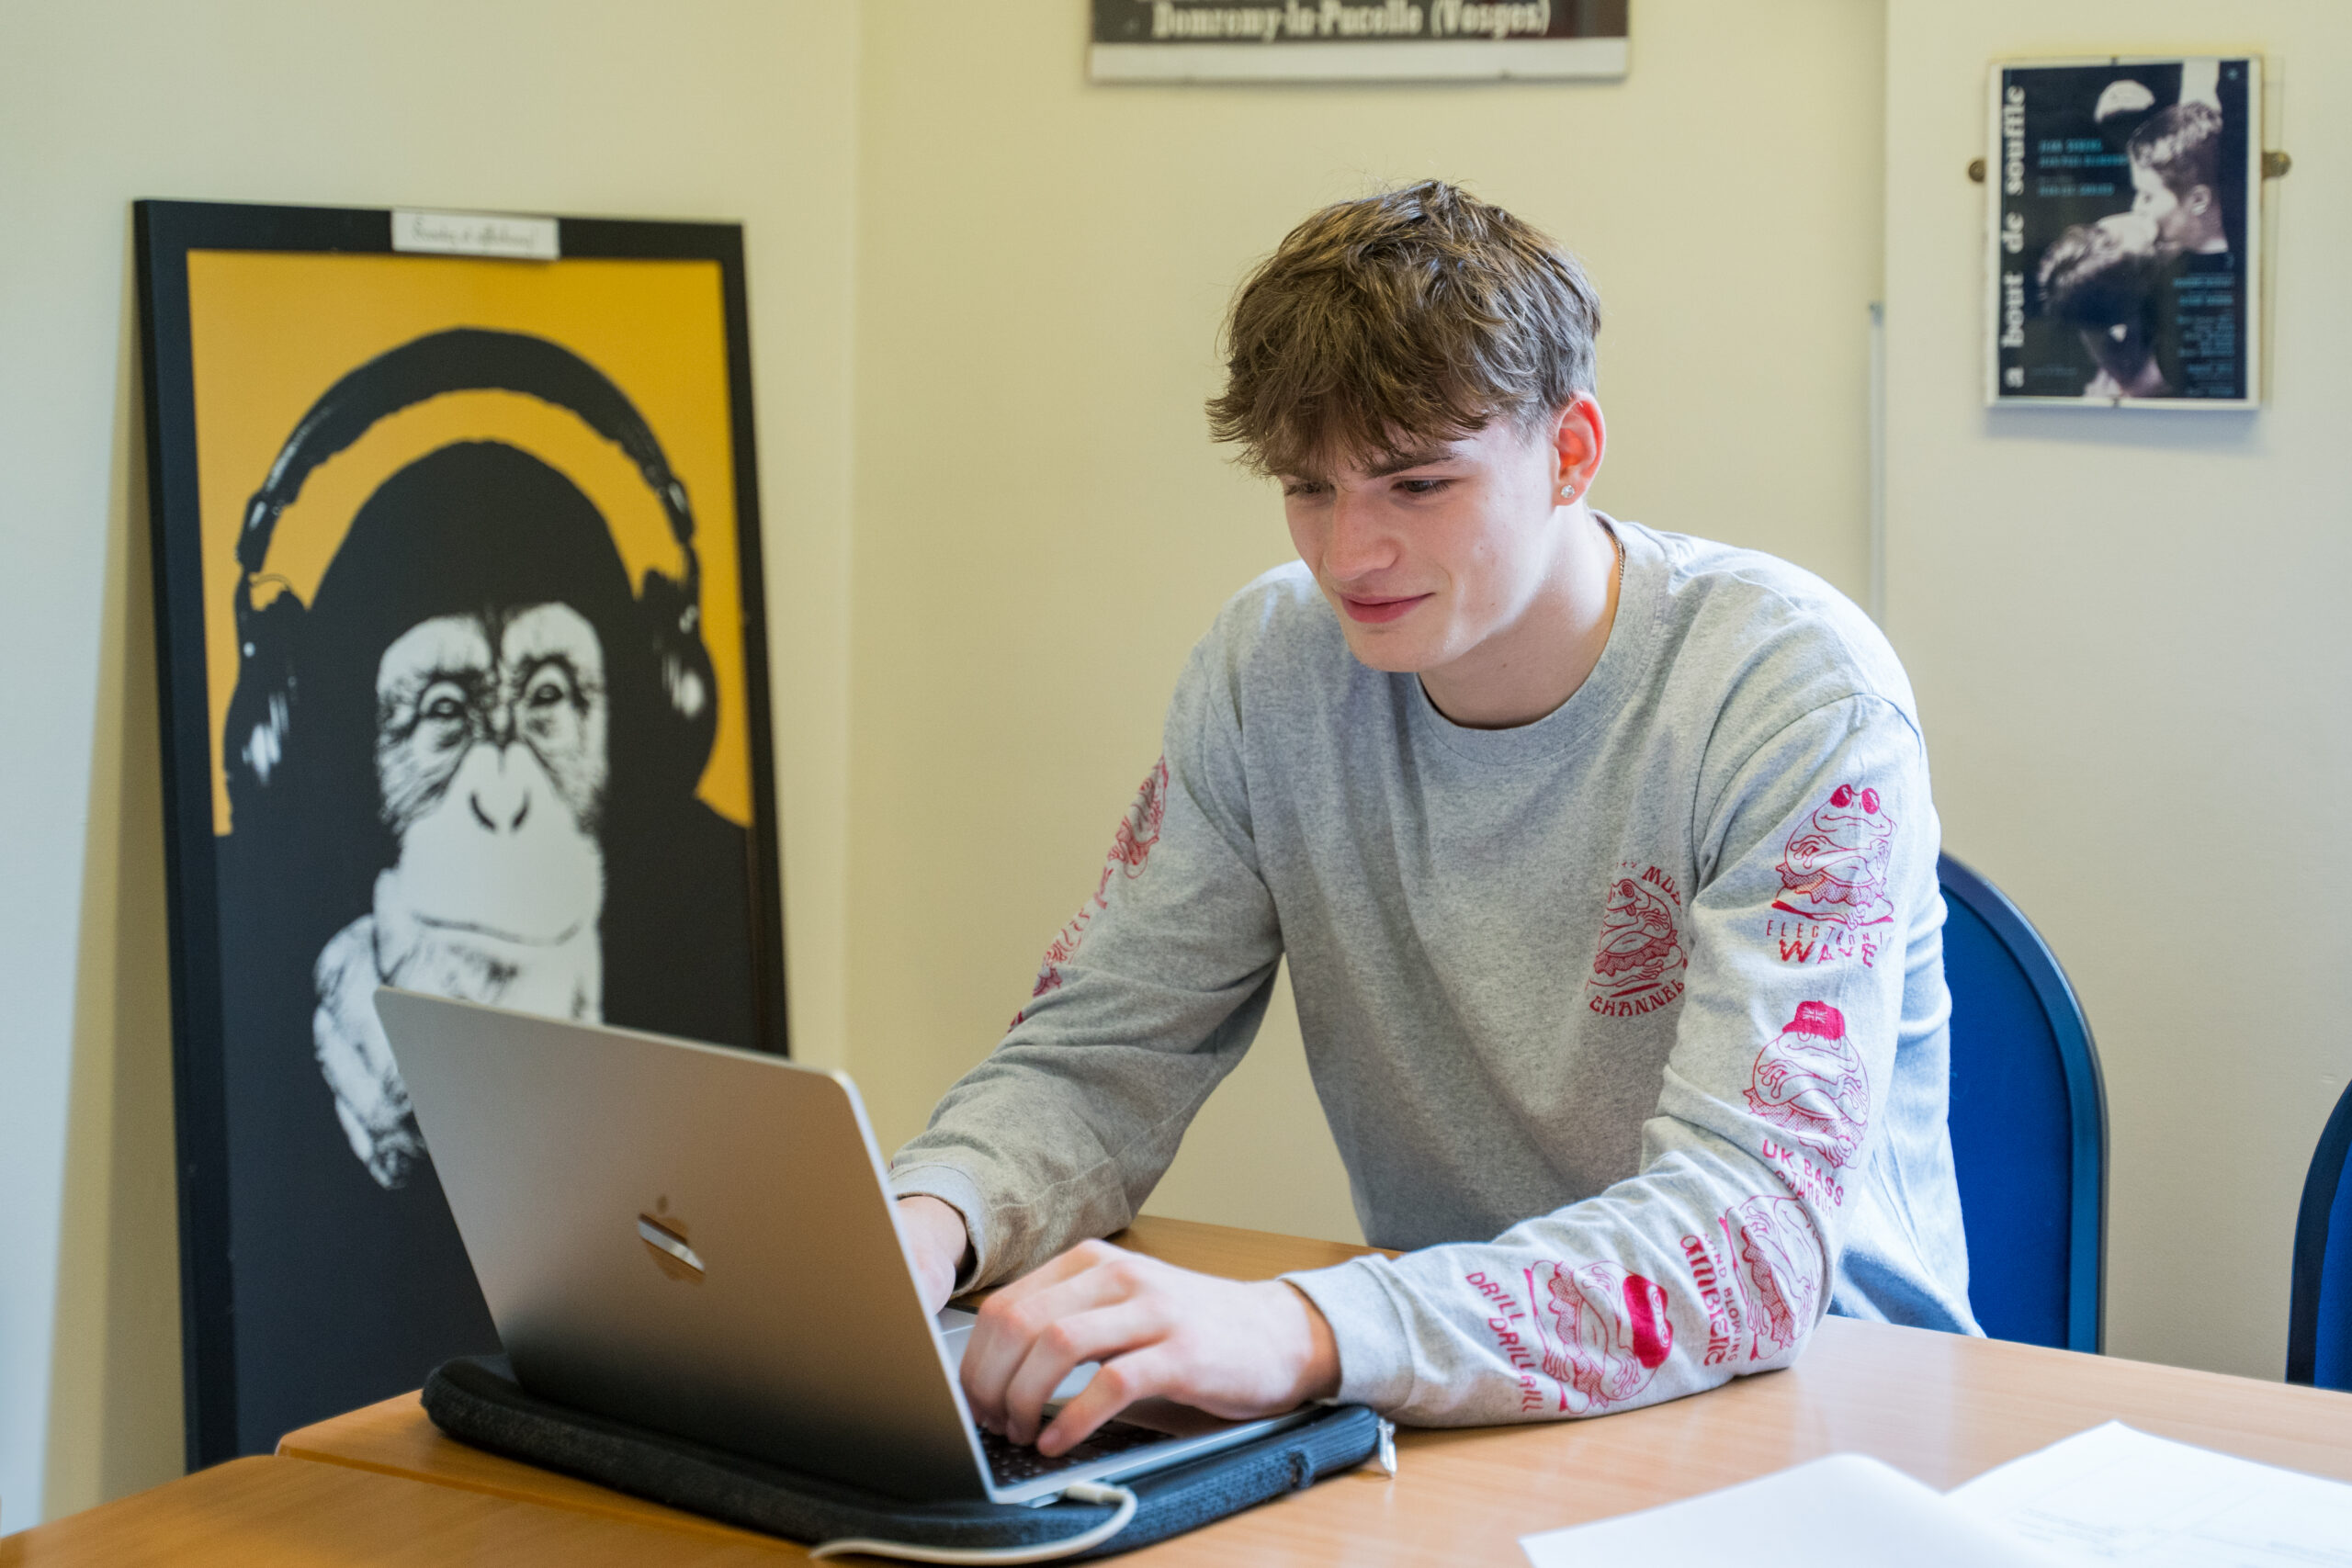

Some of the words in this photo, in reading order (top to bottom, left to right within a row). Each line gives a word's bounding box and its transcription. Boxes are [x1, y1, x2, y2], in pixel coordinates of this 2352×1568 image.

[2001, 85, 2026, 197] souffle
[2001, 211, 2024, 254] de
[2001, 272, 2025, 348] bout
[1589, 978, 1685, 1017] CHANNEL
[1762, 1138, 1794, 1169] UK
[1804, 1157, 1844, 1207] BASS
[1465, 1271, 1526, 1325] DRILL
